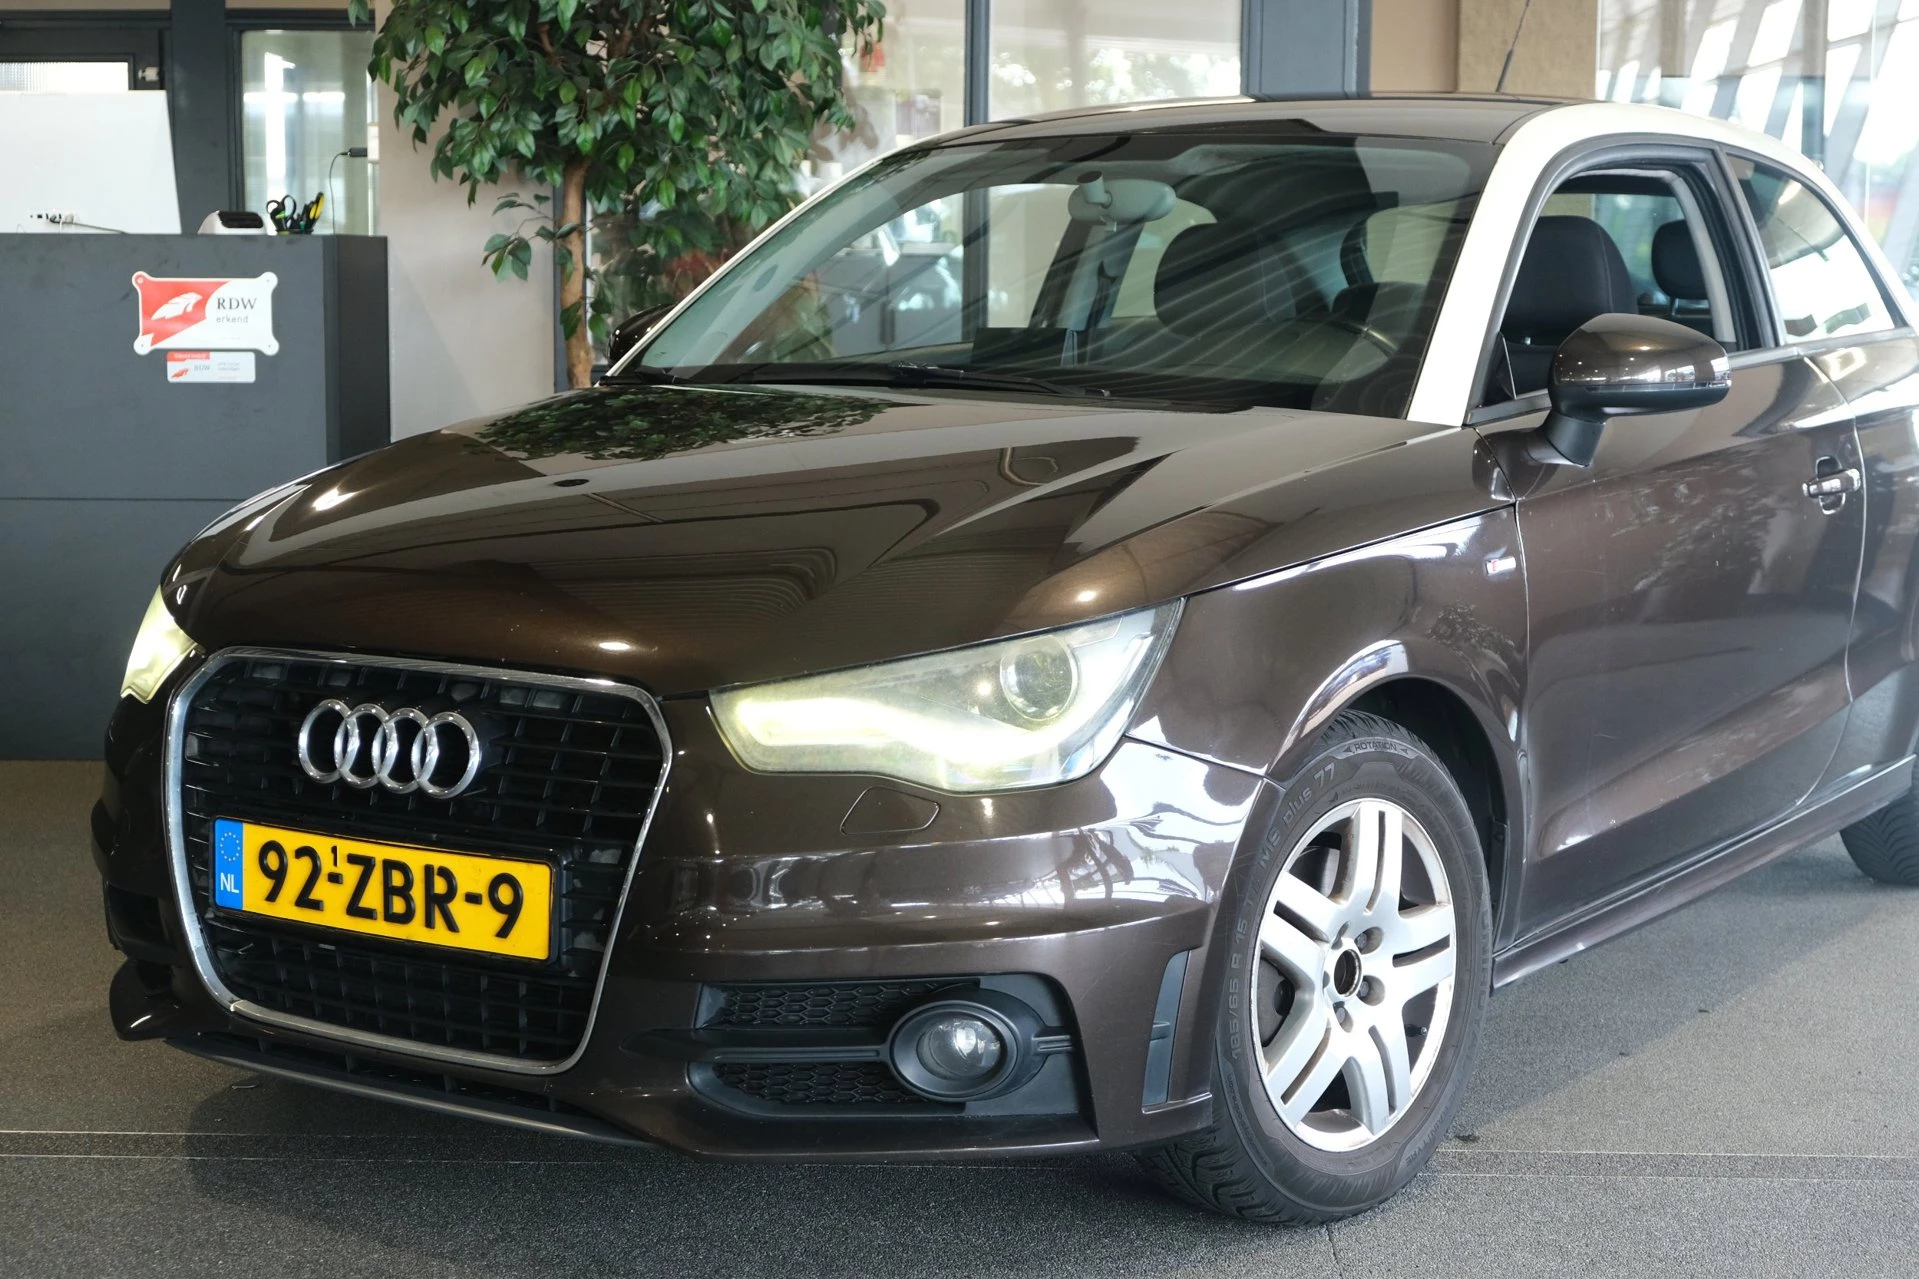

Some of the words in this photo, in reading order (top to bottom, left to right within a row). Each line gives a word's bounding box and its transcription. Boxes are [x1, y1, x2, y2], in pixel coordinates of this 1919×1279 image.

[217, 297, 257, 310] RDW
[216, 314, 249, 324] erkend
[1355, 740, 1397, 752] ROTATION
[1282, 784, 1313, 827] plus
[1313, 761, 1336, 790] 77
[220, 872, 240, 895] NL
[258, 839, 524, 940] 92-ZBR-9
[1230, 979, 1241, 1060] 185/65
